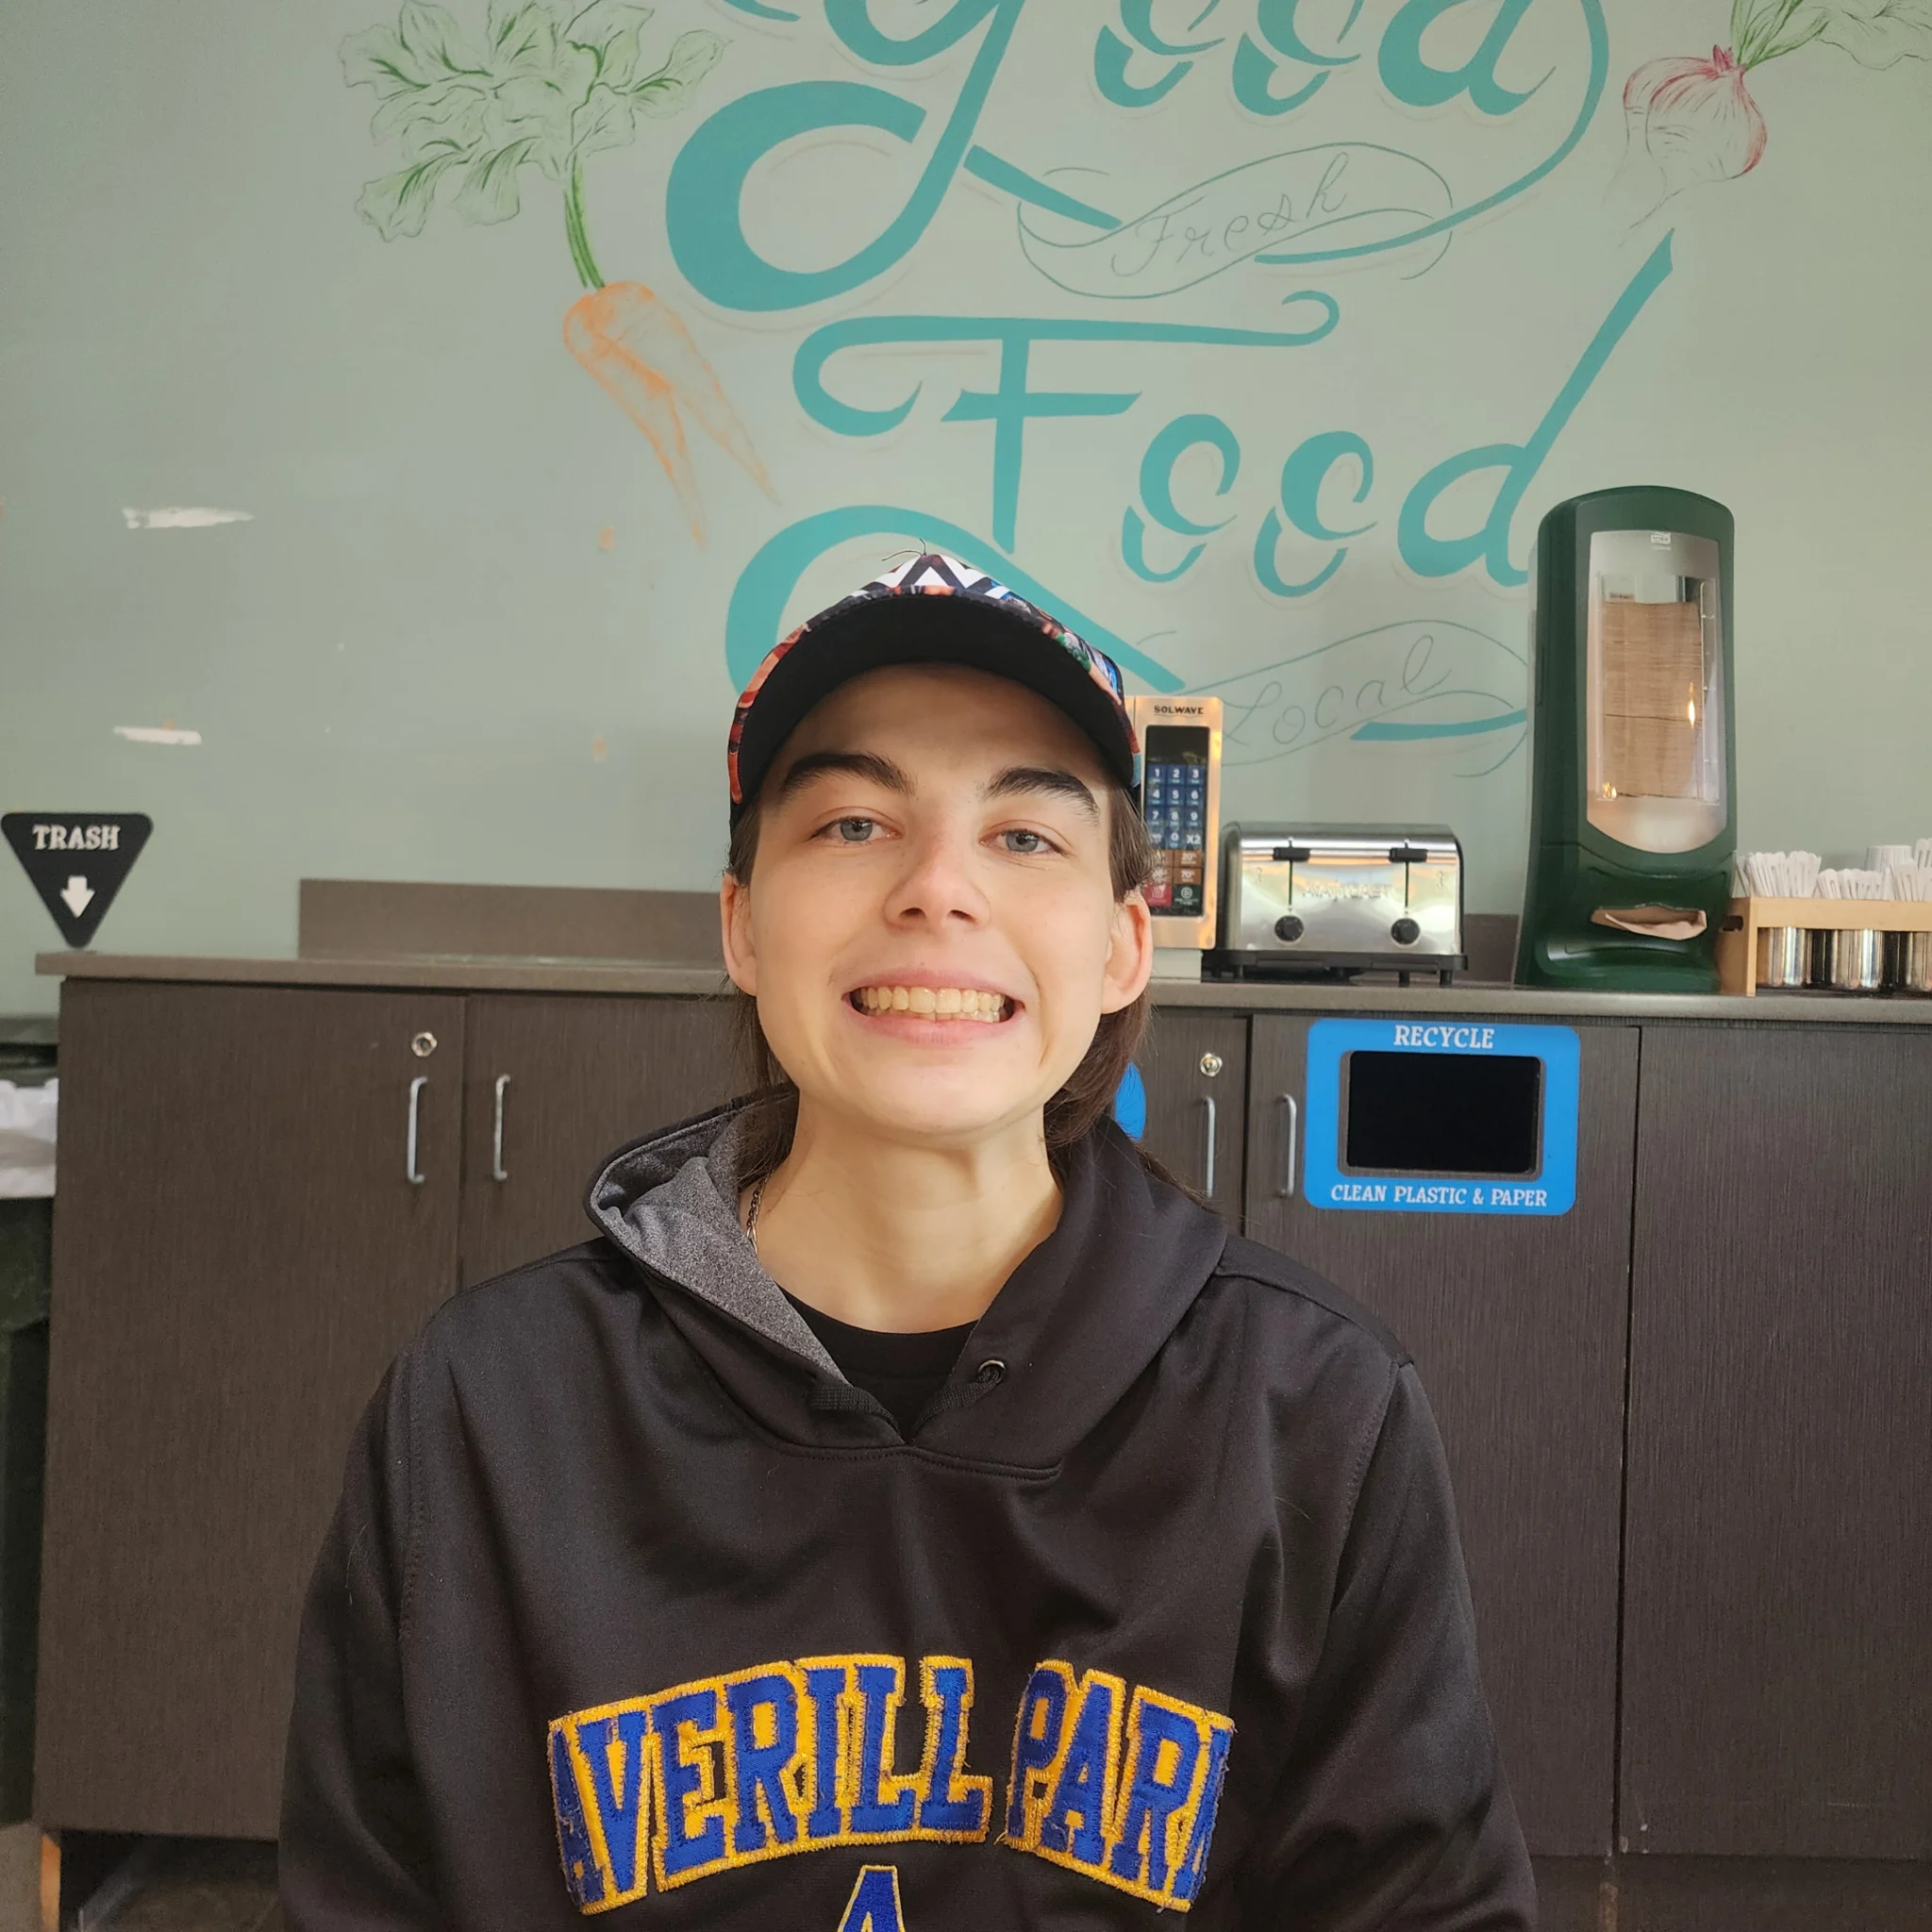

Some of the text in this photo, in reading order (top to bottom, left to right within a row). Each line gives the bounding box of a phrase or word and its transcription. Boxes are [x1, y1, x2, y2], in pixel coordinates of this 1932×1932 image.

[1110, 151, 1350, 278] Fresh
[792, 228, 1673, 597] Food
[1222, 634, 1452, 747] Local
[1154, 706, 1204, 715] SOLWAVE
[1154, 768, 1200, 778] 1 2 3
[1152, 789, 1199, 800] 4 5 6
[1152, 810, 1198, 821] 7 8 9
[32, 824, 121, 850] TRASH
[1171, 832, 1179, 841] 0
[1393, 1024, 1494, 1049] RECYCLE
[1330, 1184, 1547, 1207] CLEAN PLASTIC & PAPER
